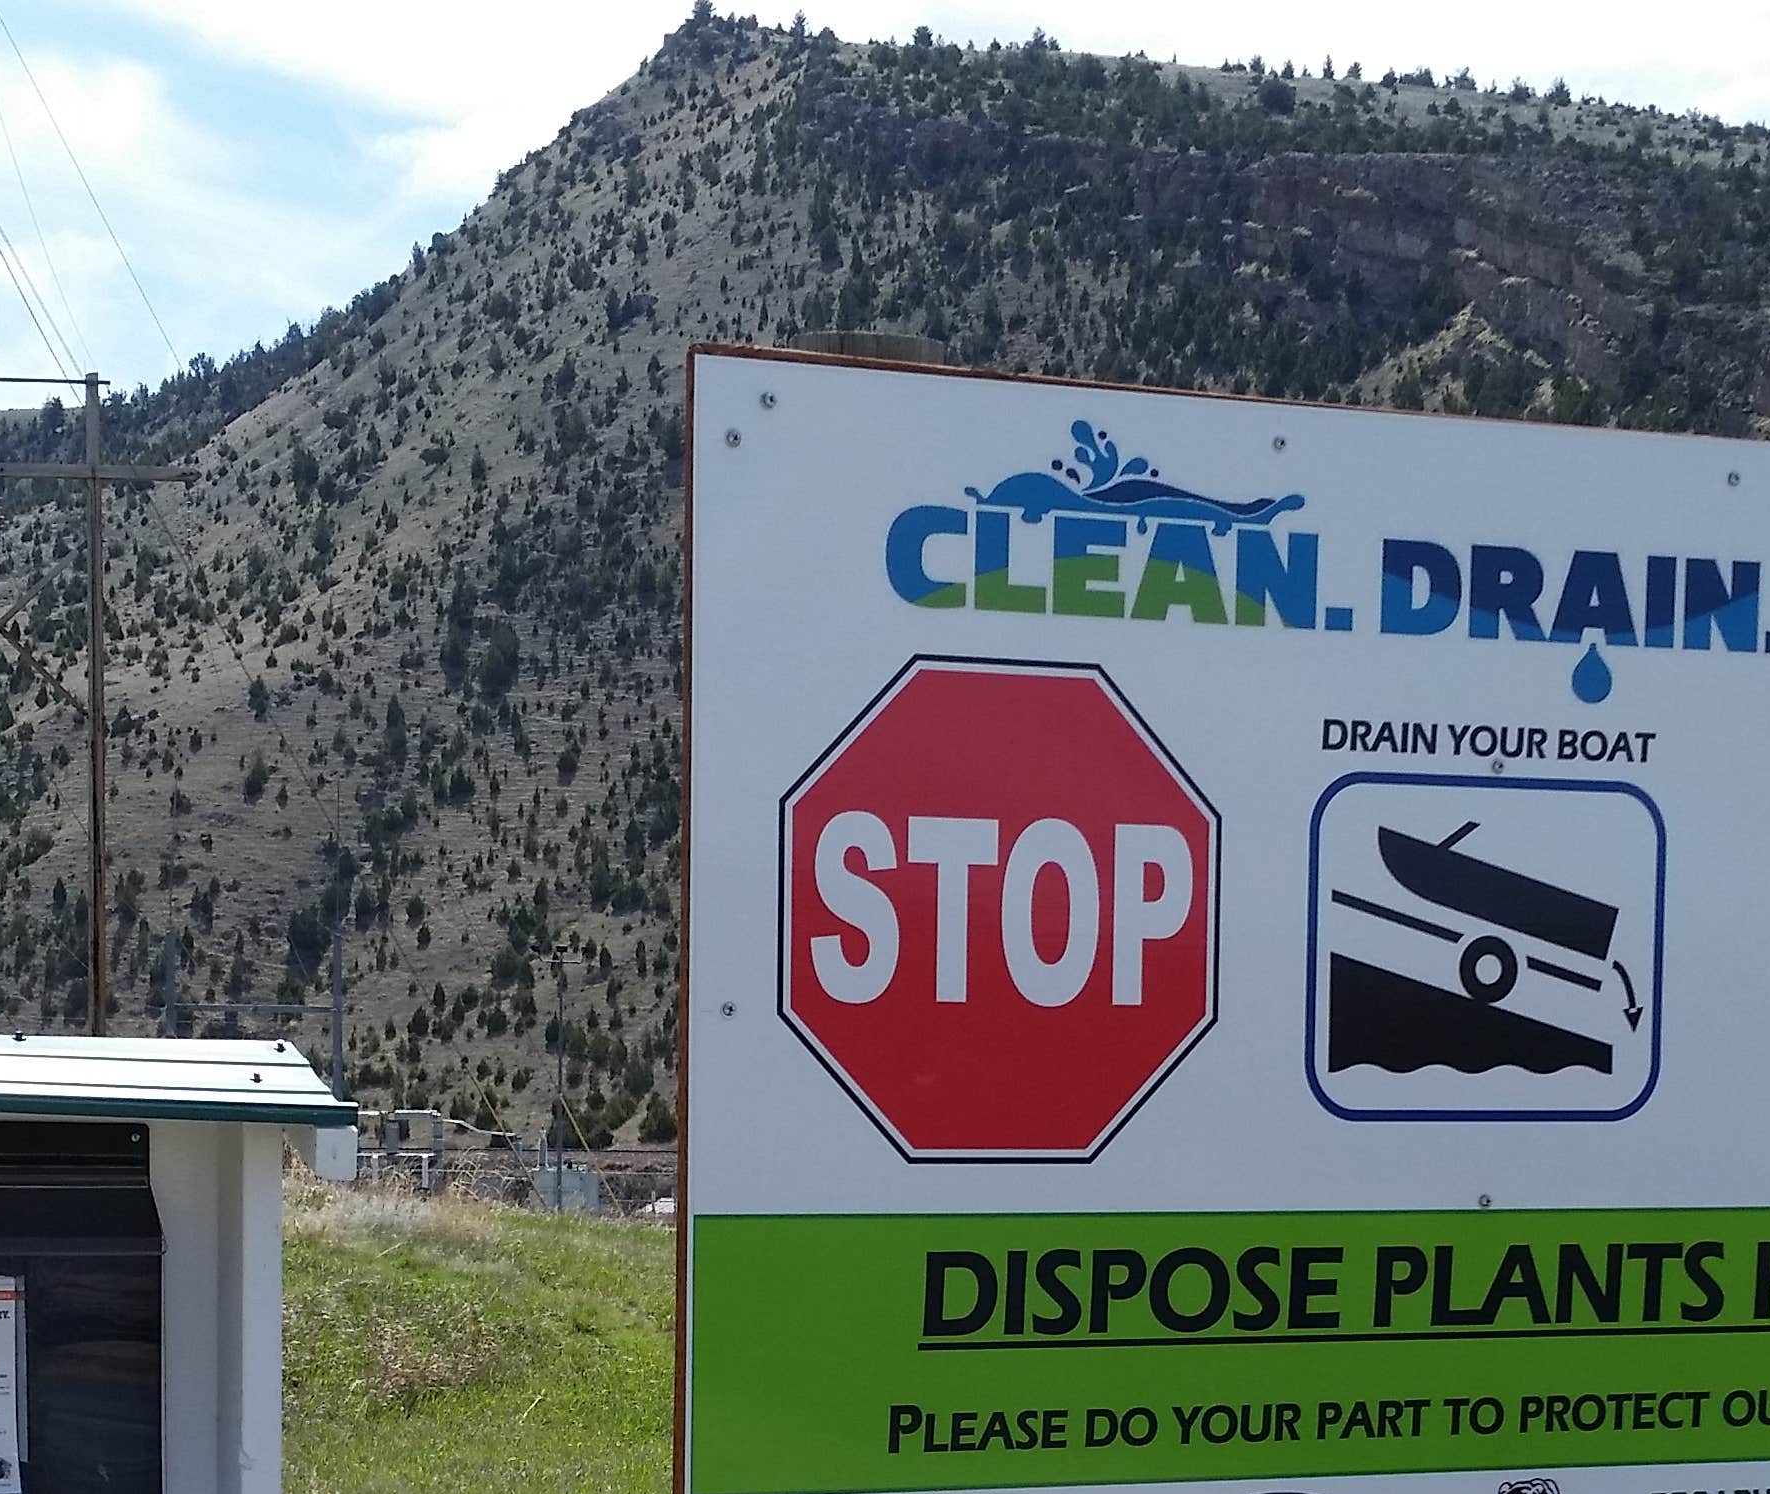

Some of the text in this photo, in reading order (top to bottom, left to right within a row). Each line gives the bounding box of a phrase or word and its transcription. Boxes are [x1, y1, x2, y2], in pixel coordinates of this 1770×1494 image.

[885, 504, 1353, 632] CLEAN.
[1321, 718, 1657, 763] DRAIN YOUR BOAT
[809, 809, 1195, 1008] STOP
[921, 1244, 1345, 1338] DISPOSE
[1372, 1240, 1726, 1329] PLANTS
[887, 1403, 1070, 1455] PLEASE
[1084, 1405, 1159, 1449] DO
[1171, 1402, 1302, 1446] YOUR
[1316, 1398, 1431, 1440] PART
[1443, 1397, 1505, 1436] TO
[1518, 1390, 1710, 1434] PROTECT
